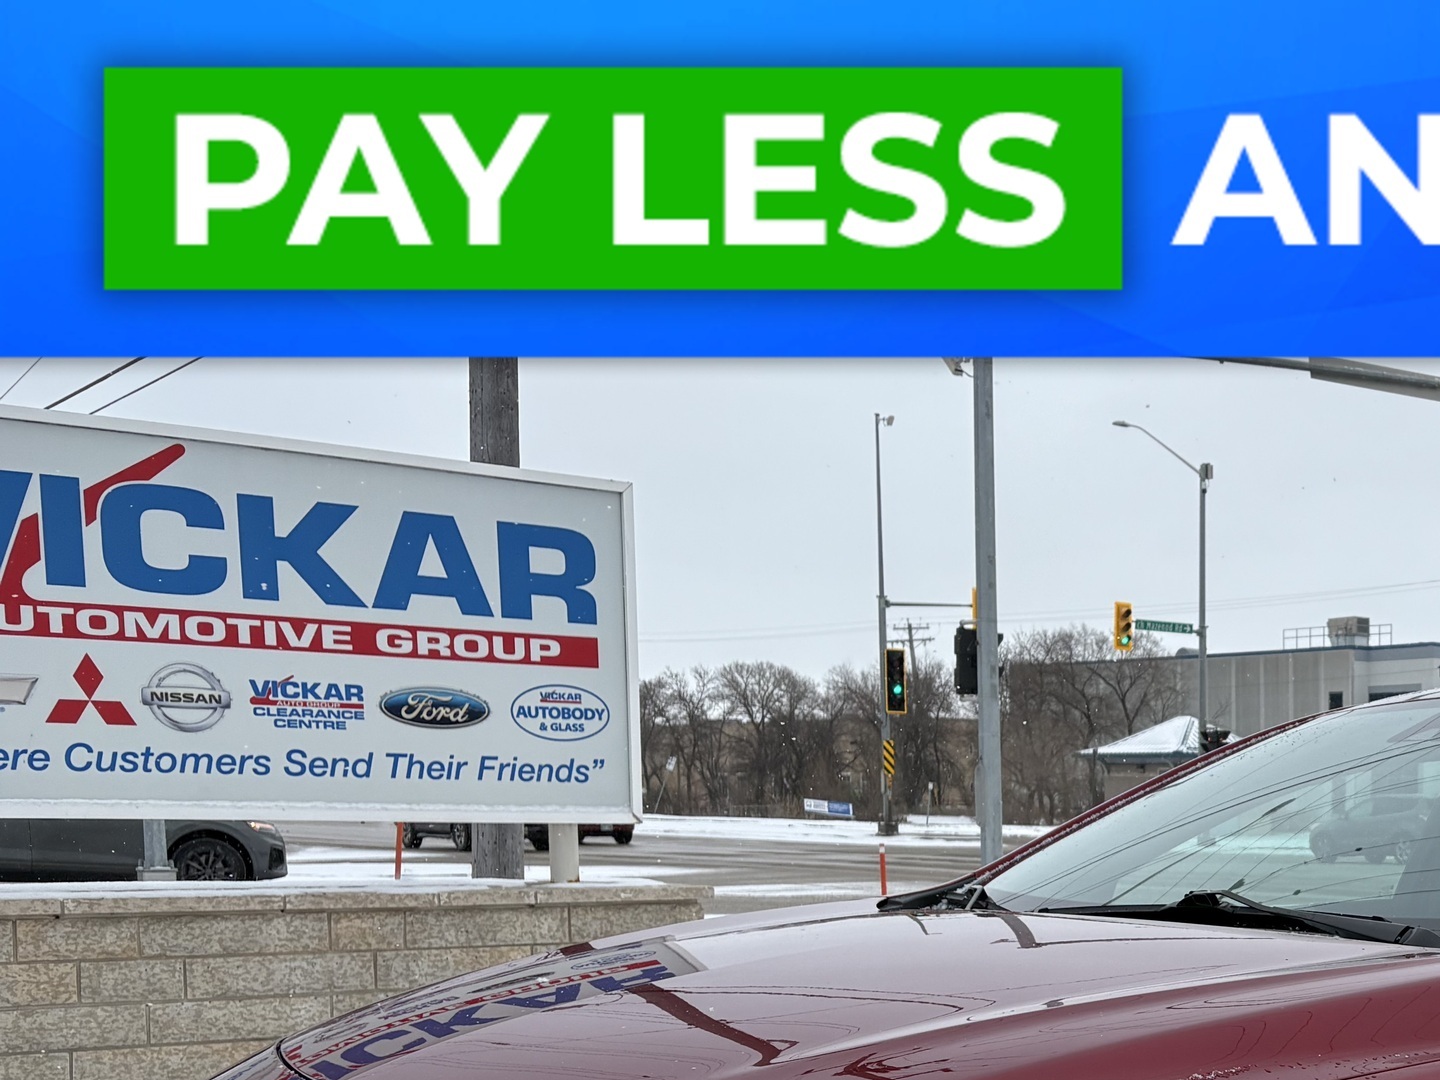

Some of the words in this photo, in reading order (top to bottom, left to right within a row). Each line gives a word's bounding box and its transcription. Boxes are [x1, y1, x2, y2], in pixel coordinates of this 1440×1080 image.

[375, 628, 561, 662] GROUP
[249, 679, 364, 702] VICKAR
[540, 690, 582, 701] VICKAR
[150, 691, 222, 705] NISSAN
[306, 701, 341, 709] GROUP
[253, 707, 365, 720] CLEARANCE
[401, 692, 471, 723] Ford
[516, 705, 605, 722] AUTOBODY
[274, 718, 347, 730] CENTRE
[539, 722, 548, 732] &
[550, 722, 585, 732] GLASS
[65, 742, 271, 777] Customers
[284, 748, 374, 779] Send
[385, 752, 468, 781] Their
[477, 755, 605, 784] Friends”
